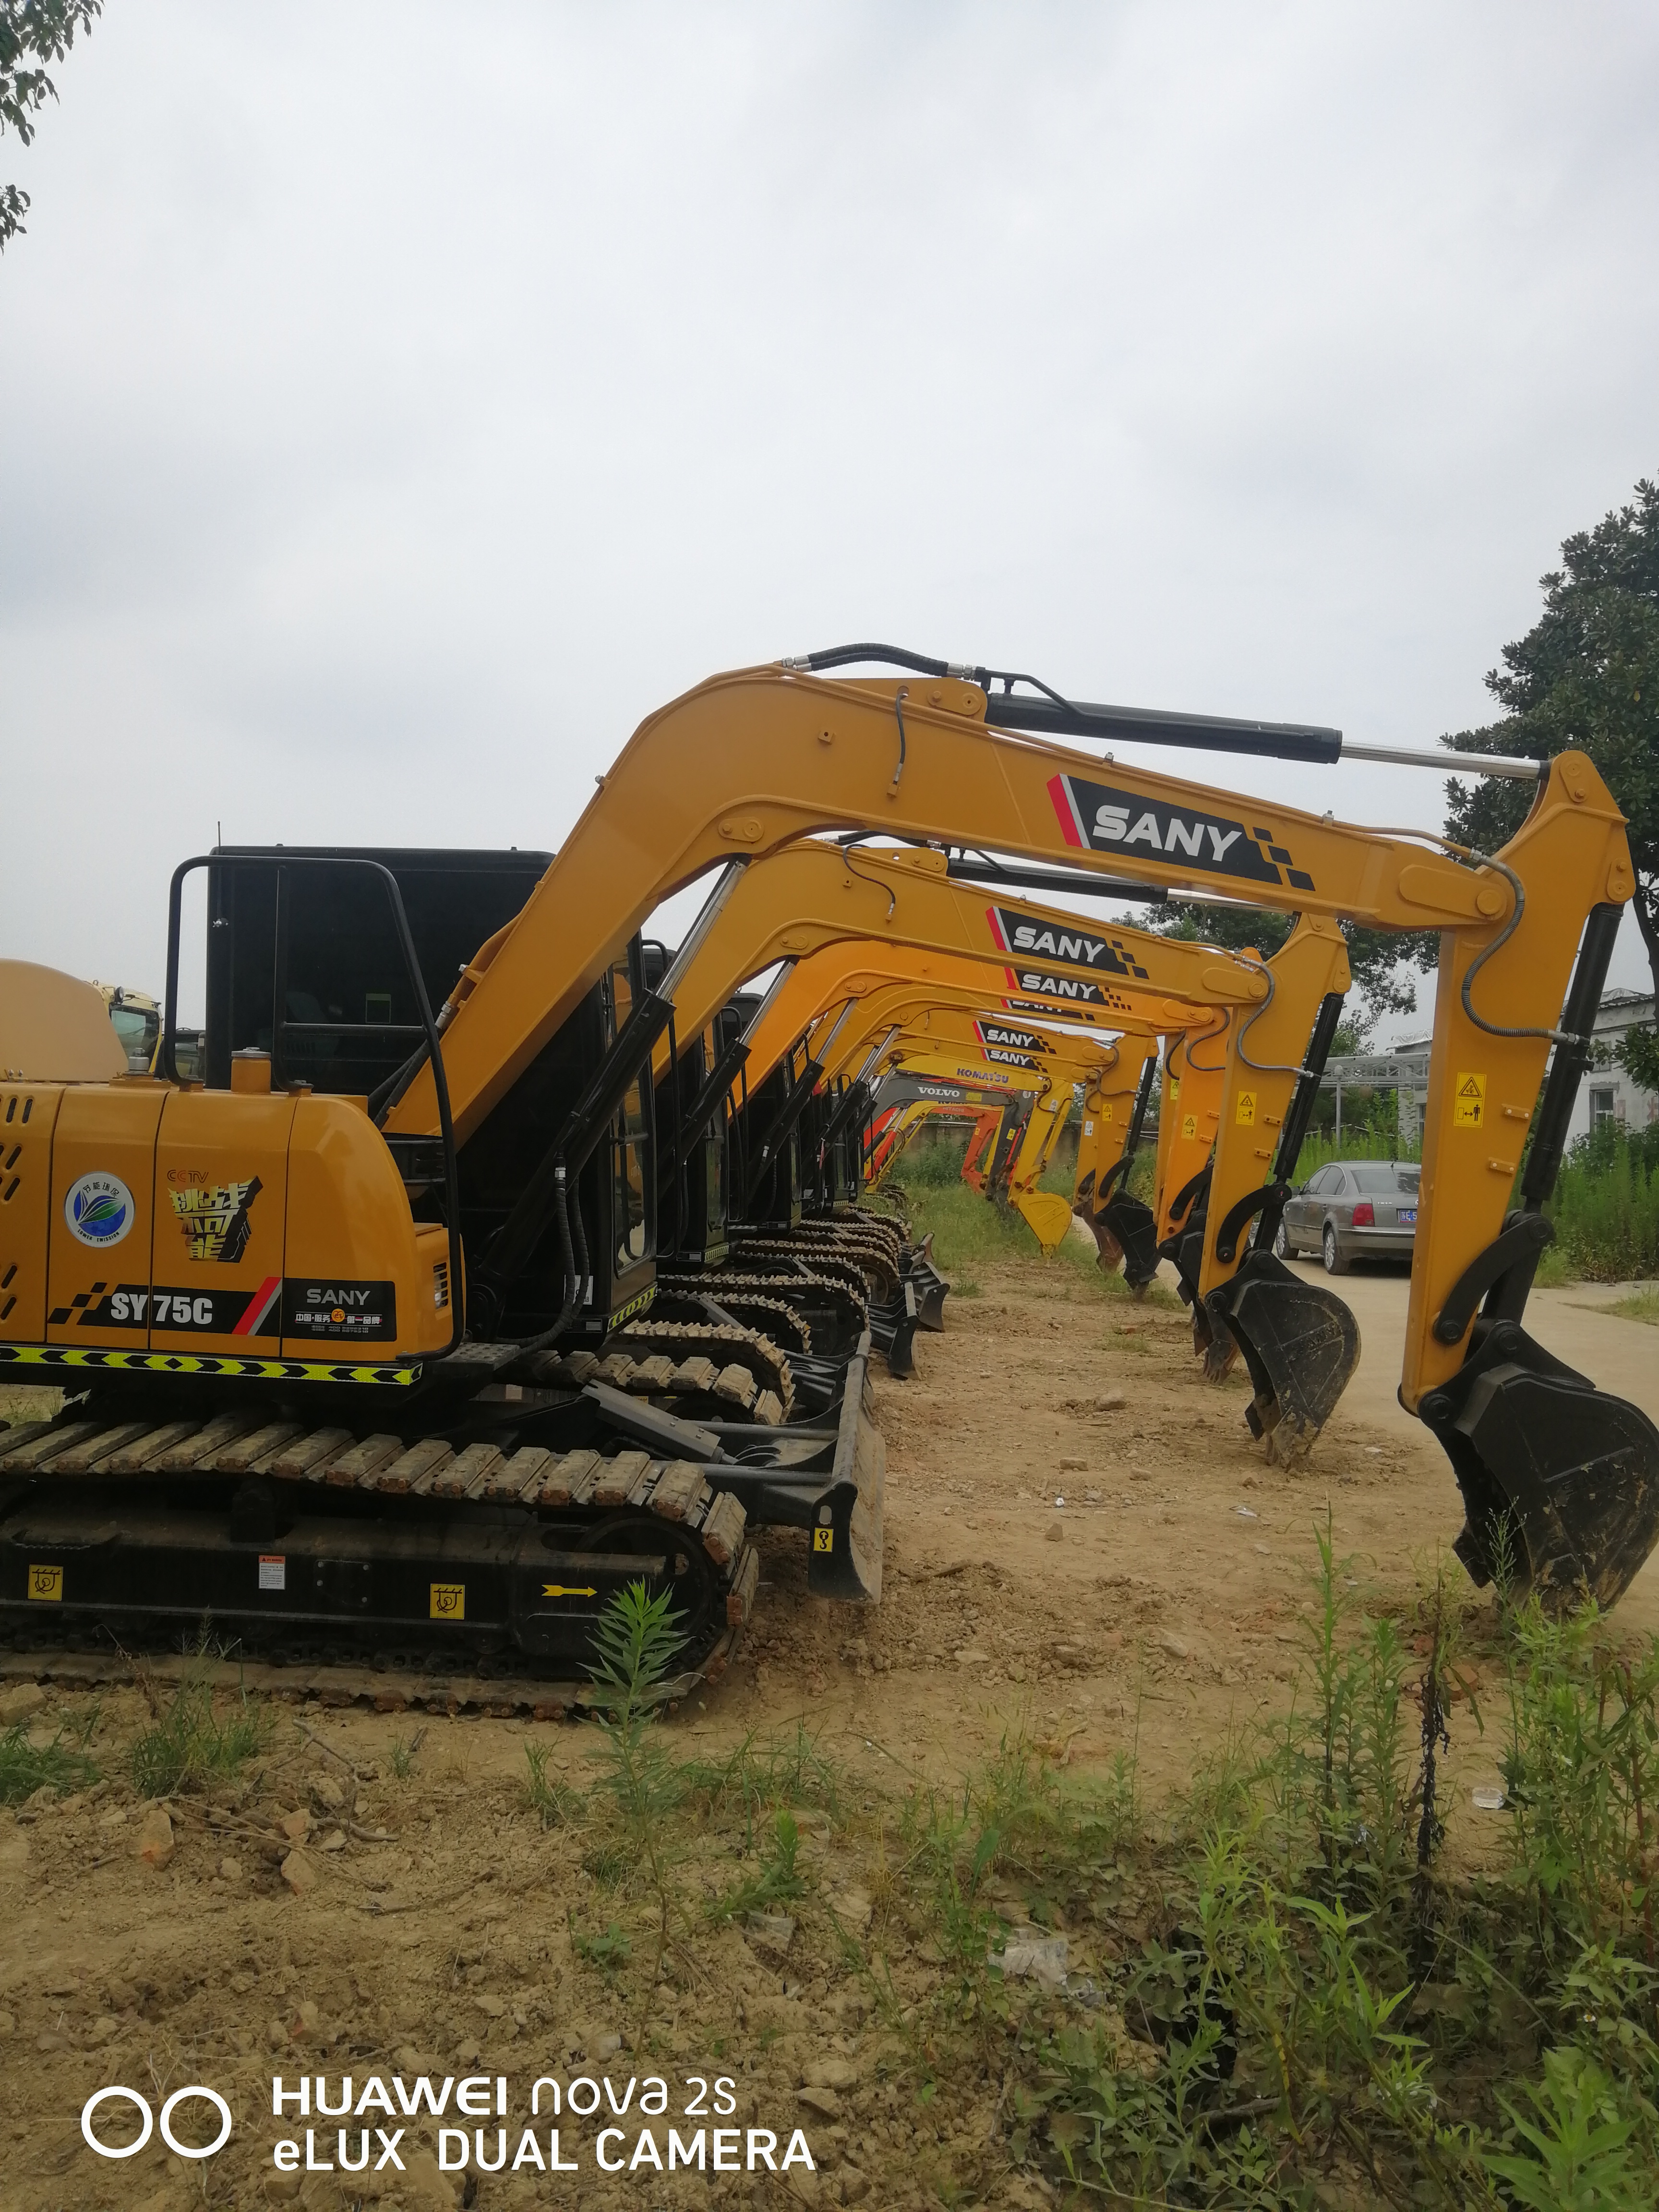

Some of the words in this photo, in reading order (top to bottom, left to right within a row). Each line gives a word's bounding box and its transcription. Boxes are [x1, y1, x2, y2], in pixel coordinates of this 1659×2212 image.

[1093, 805, 1242, 862] SANY
[1013, 926, 1105, 962] SANY
[1022, 974, 1096, 999] SANY
[987, 1029, 1034, 1047] SANY
[990, 1050, 1030, 1066] SANY
[957, 1068, 1009, 1083] KOMATSU
[918, 1087, 960, 1097] VOLVO
[167, 1169, 209, 1183] CCTV
[83, 1182, 120, 1198] 节能环保
[168, 1182, 249, 1212] 挑战
[77, 1229, 93, 1240] LOWER
[97, 1231, 120, 1242] EMISSION
[185, 1234, 227, 1259] 能
[306, 1288, 371, 1305] SANY
[296, 1313, 330, 1322] 中国·服务
[347, 1315, 381, 1324] 第一品牌
